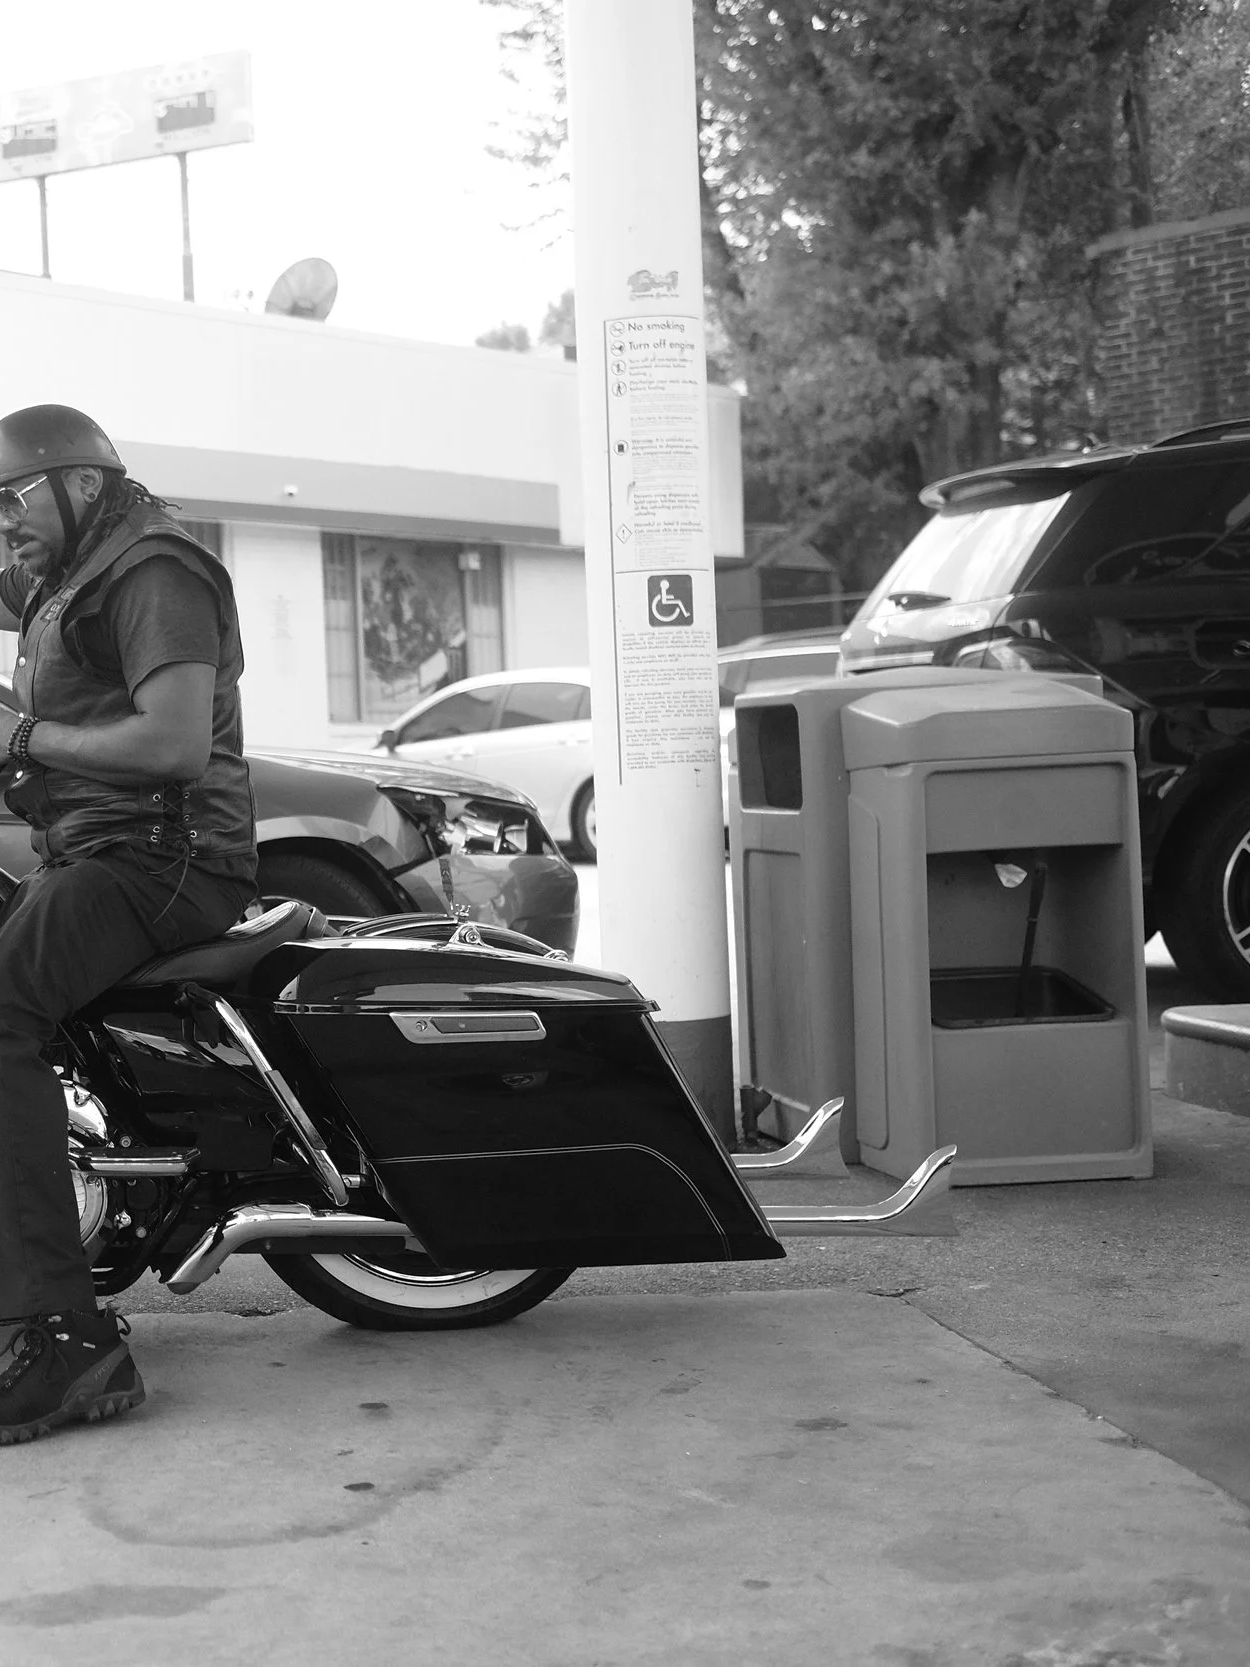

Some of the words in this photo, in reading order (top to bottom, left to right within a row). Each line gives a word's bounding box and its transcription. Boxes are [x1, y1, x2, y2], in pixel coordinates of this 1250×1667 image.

[628, 322, 643, 332] No
[646, 319, 685, 333] smoking
[628, 341, 650, 351] Turn
[652, 338, 667, 349] off
[669, 341, 695, 353] engine
